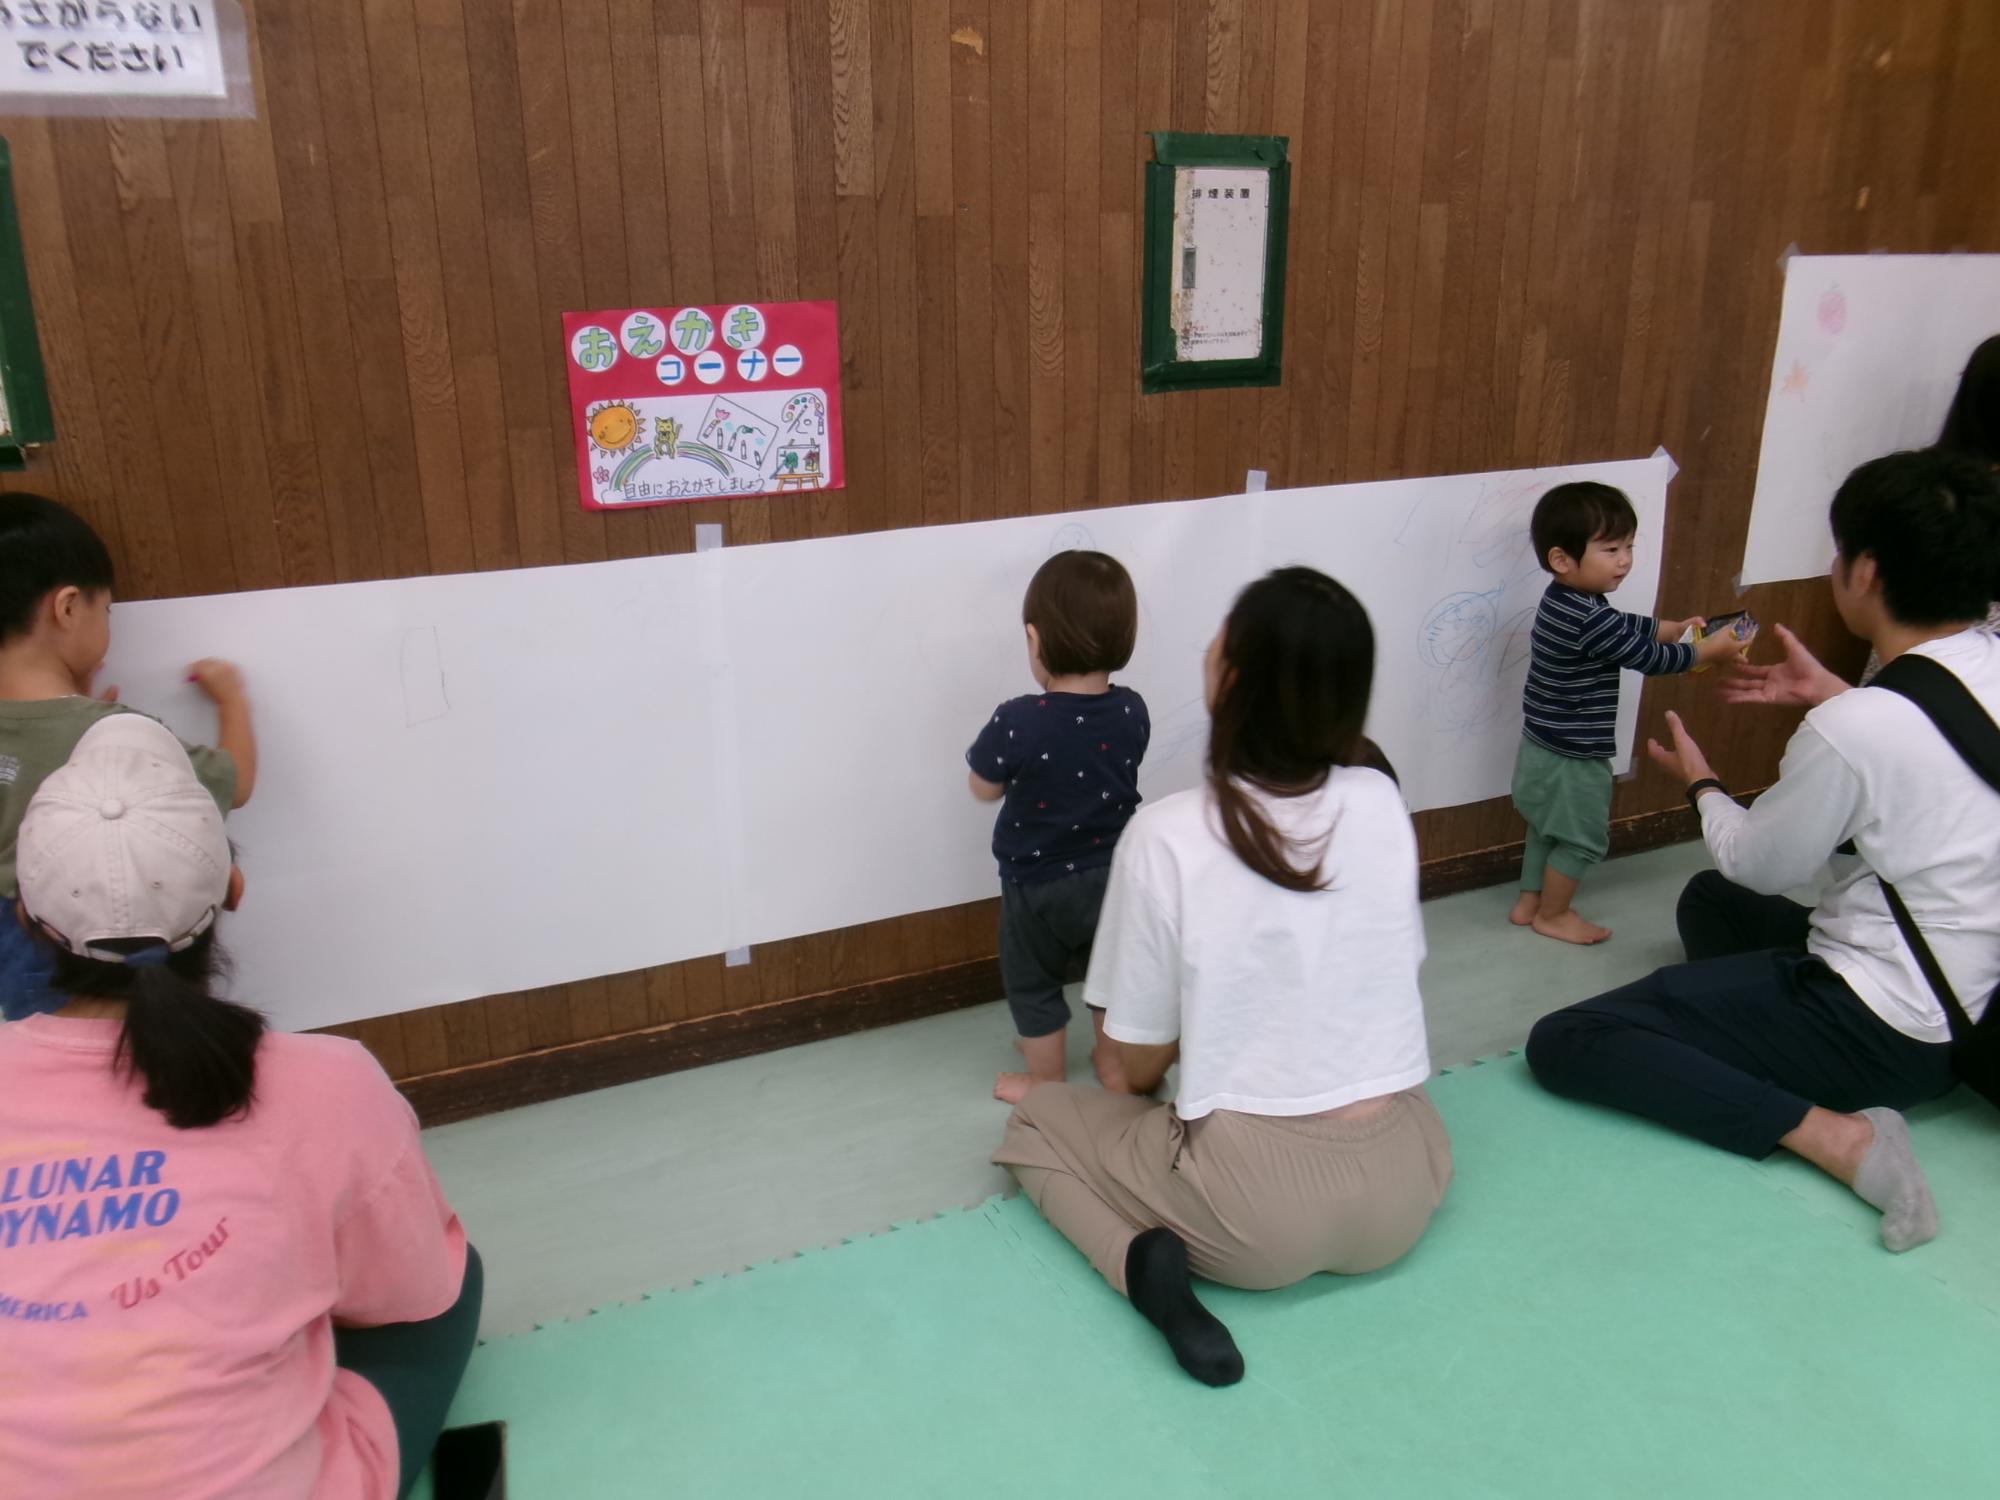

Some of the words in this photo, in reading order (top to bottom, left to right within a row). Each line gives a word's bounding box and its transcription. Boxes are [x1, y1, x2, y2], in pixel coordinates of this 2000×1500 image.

[17, 40, 184, 72] でください
[579, 307, 759, 369] おえかき
[660, 350, 801, 381] コーナー
[2, 1150, 167, 1204] LUNAR
[0, 1188, 181, 1248] YNAMO
[110, 1276, 162, 1311] Us
[163, 1216, 230, 1281] Tour
